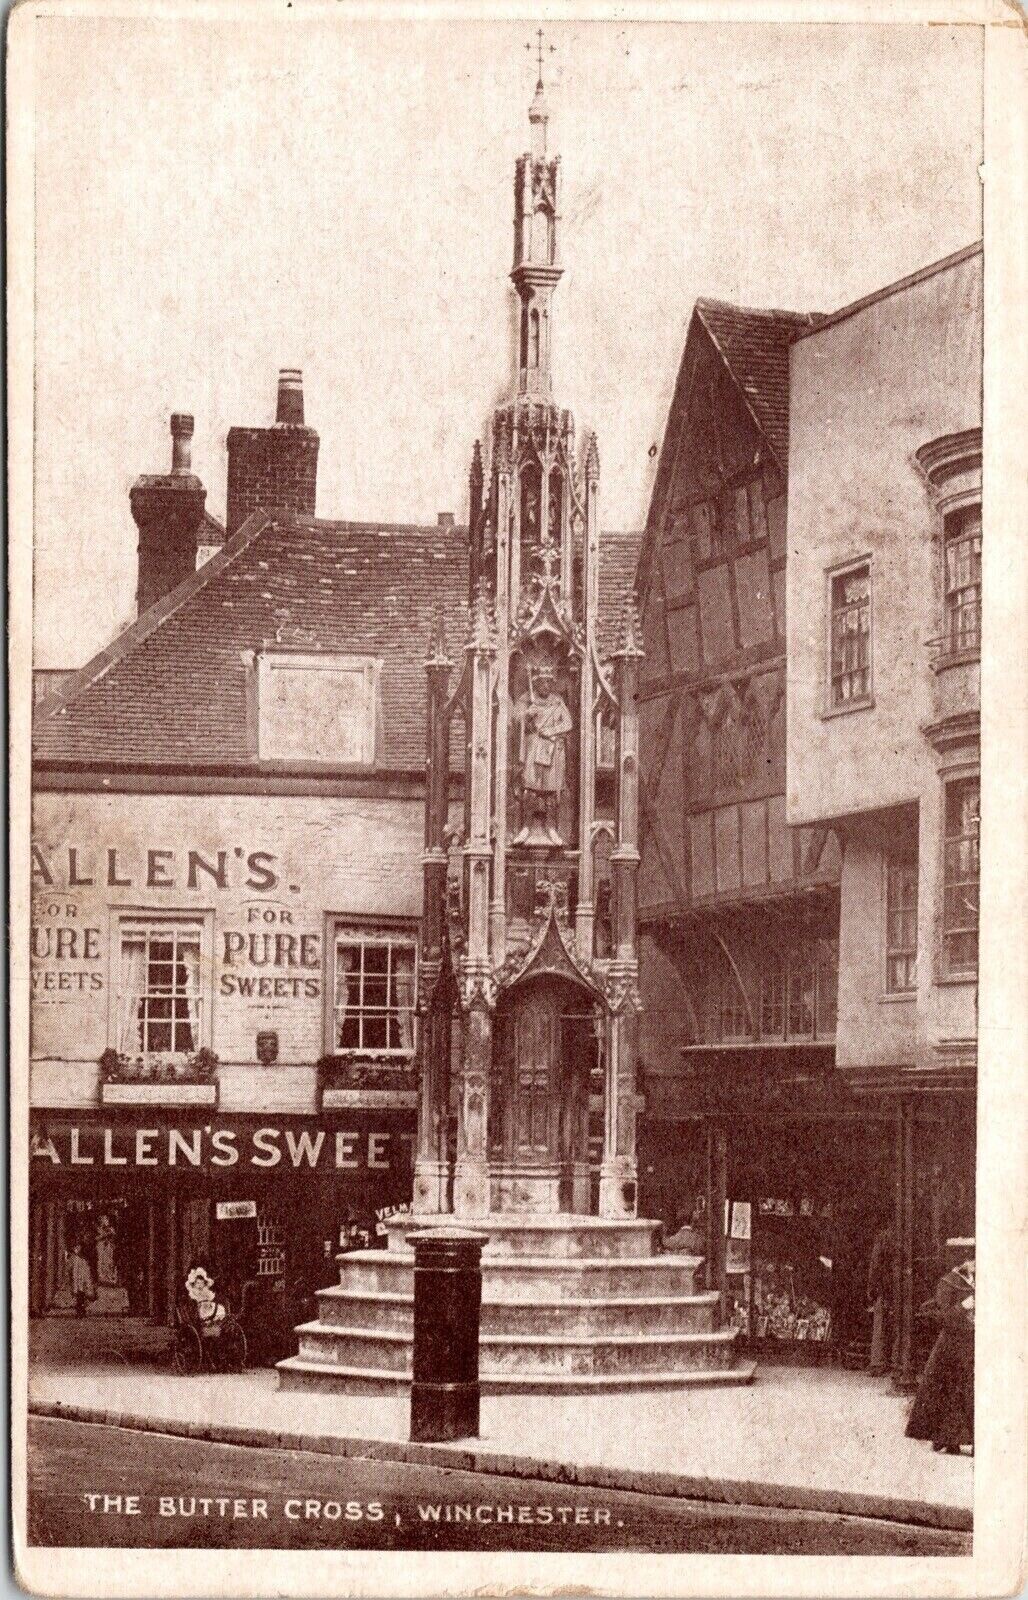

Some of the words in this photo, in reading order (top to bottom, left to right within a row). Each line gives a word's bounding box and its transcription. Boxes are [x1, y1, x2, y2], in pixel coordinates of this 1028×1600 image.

[247, 907, 293, 924] FOR
[222, 931, 321, 968] PURE
[220, 973, 321, 998] SWEETS
[32, 1125, 239, 1166] ALLEN'S
